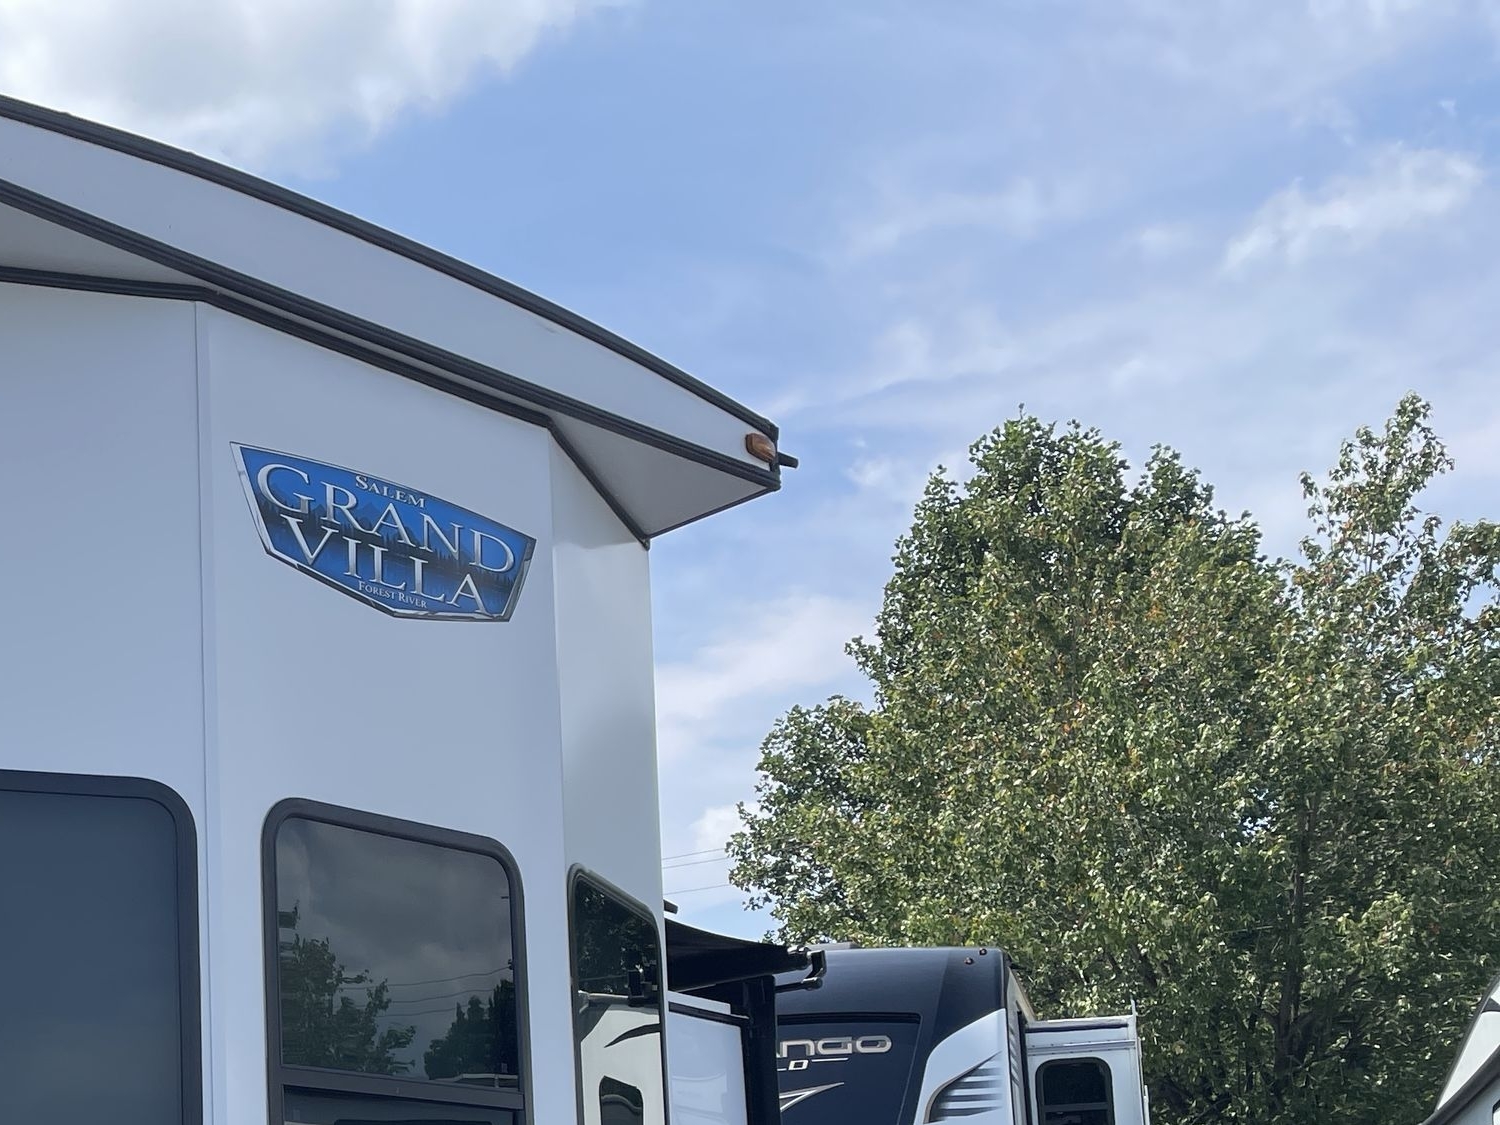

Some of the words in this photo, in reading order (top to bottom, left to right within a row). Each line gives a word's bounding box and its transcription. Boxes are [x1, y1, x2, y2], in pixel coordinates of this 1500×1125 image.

[355, 475, 425, 508] SALEM
[257, 463, 514, 573] GRAND
[280, 514, 493, 616] VILLA
[358, 580, 396, 599] FOREST
[397, 591, 427, 608] RIVER
[776, 1035, 892, 1058] NGO
